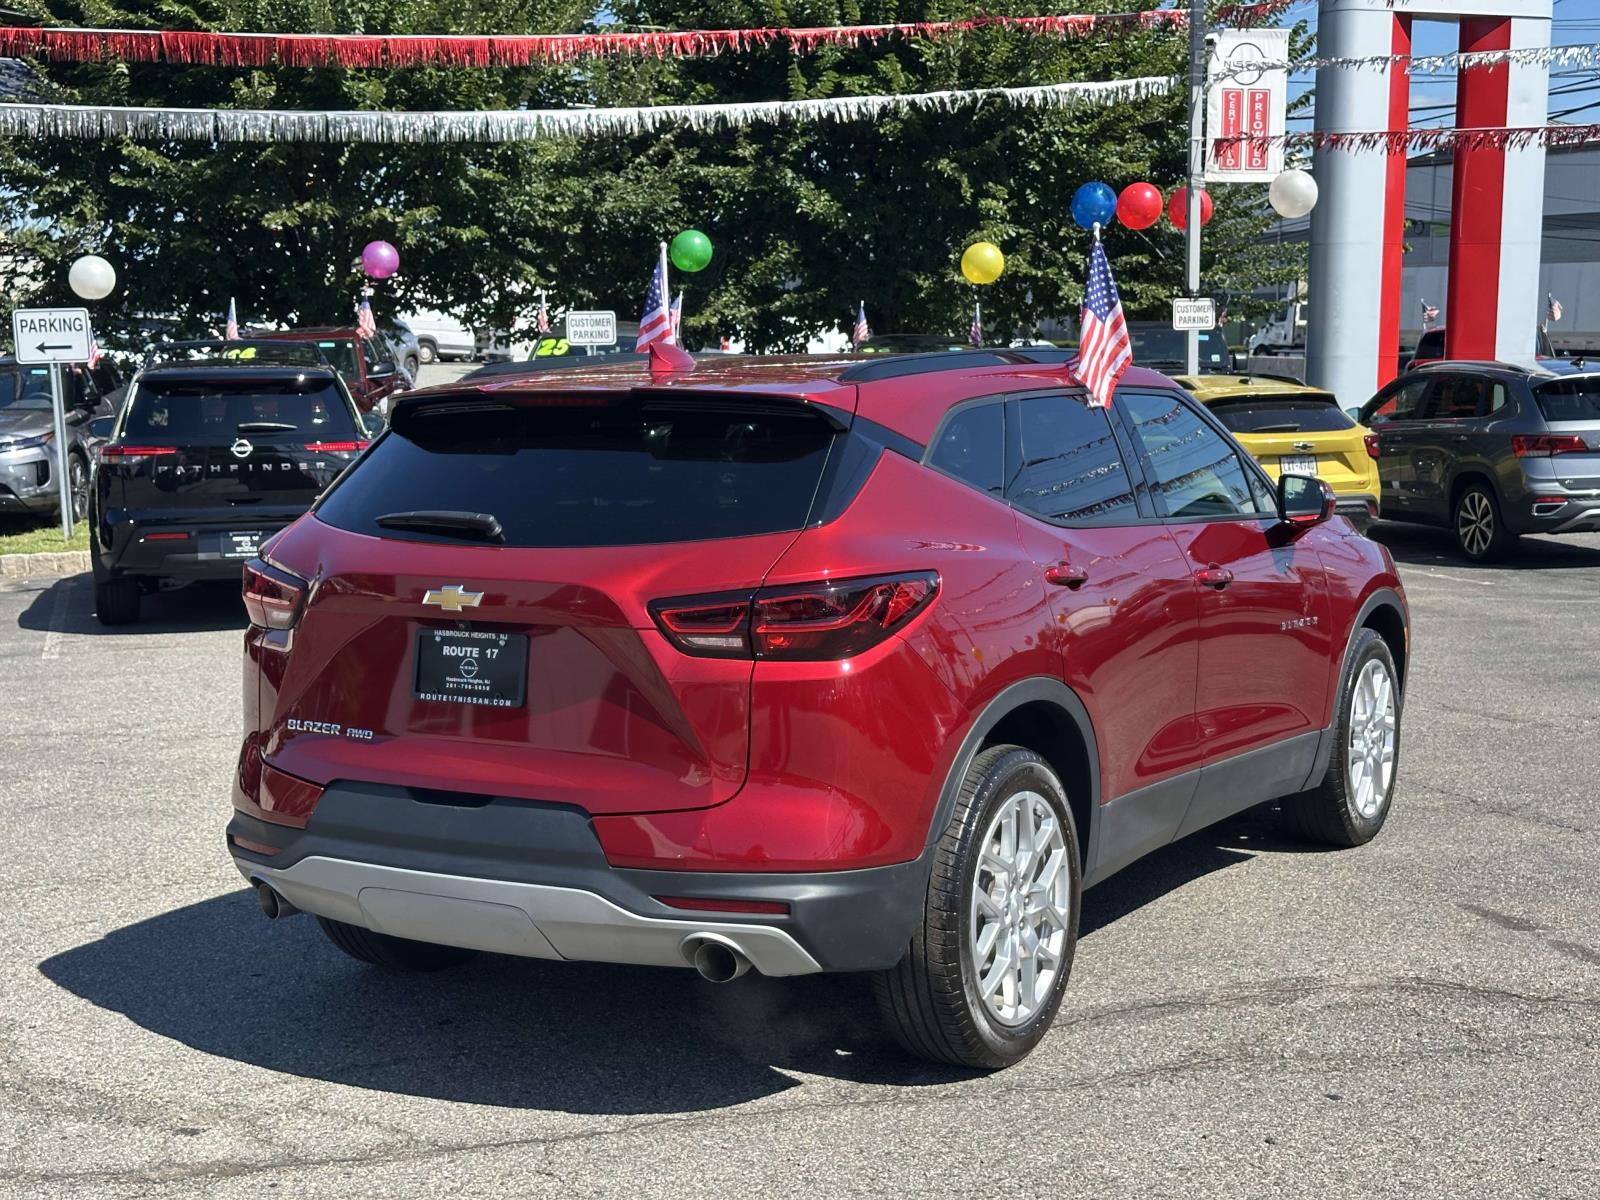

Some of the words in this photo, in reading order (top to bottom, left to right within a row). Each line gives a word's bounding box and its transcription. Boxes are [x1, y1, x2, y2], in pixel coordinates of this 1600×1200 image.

[1176, 305, 1212, 314] CUSTOMER
[20, 317, 83, 333] PARKING
[570, 318, 612, 327] CUSTOMER
[1178, 316, 1209, 324] PARKING
[573, 330, 609, 339] PARKING
[536, 339, 569, 356] 25
[158, 462, 326, 473] PATHFINDER
[434, 630, 469, 638] HASBROUCK
[442, 646, 480, 657] ROUTE
[486, 649, 498, 659] 17
[420, 693, 511, 706] ROUTE17NISSAN.COM
[287, 719, 341, 735] BLAZER
[346, 727, 373, 739] AWD
